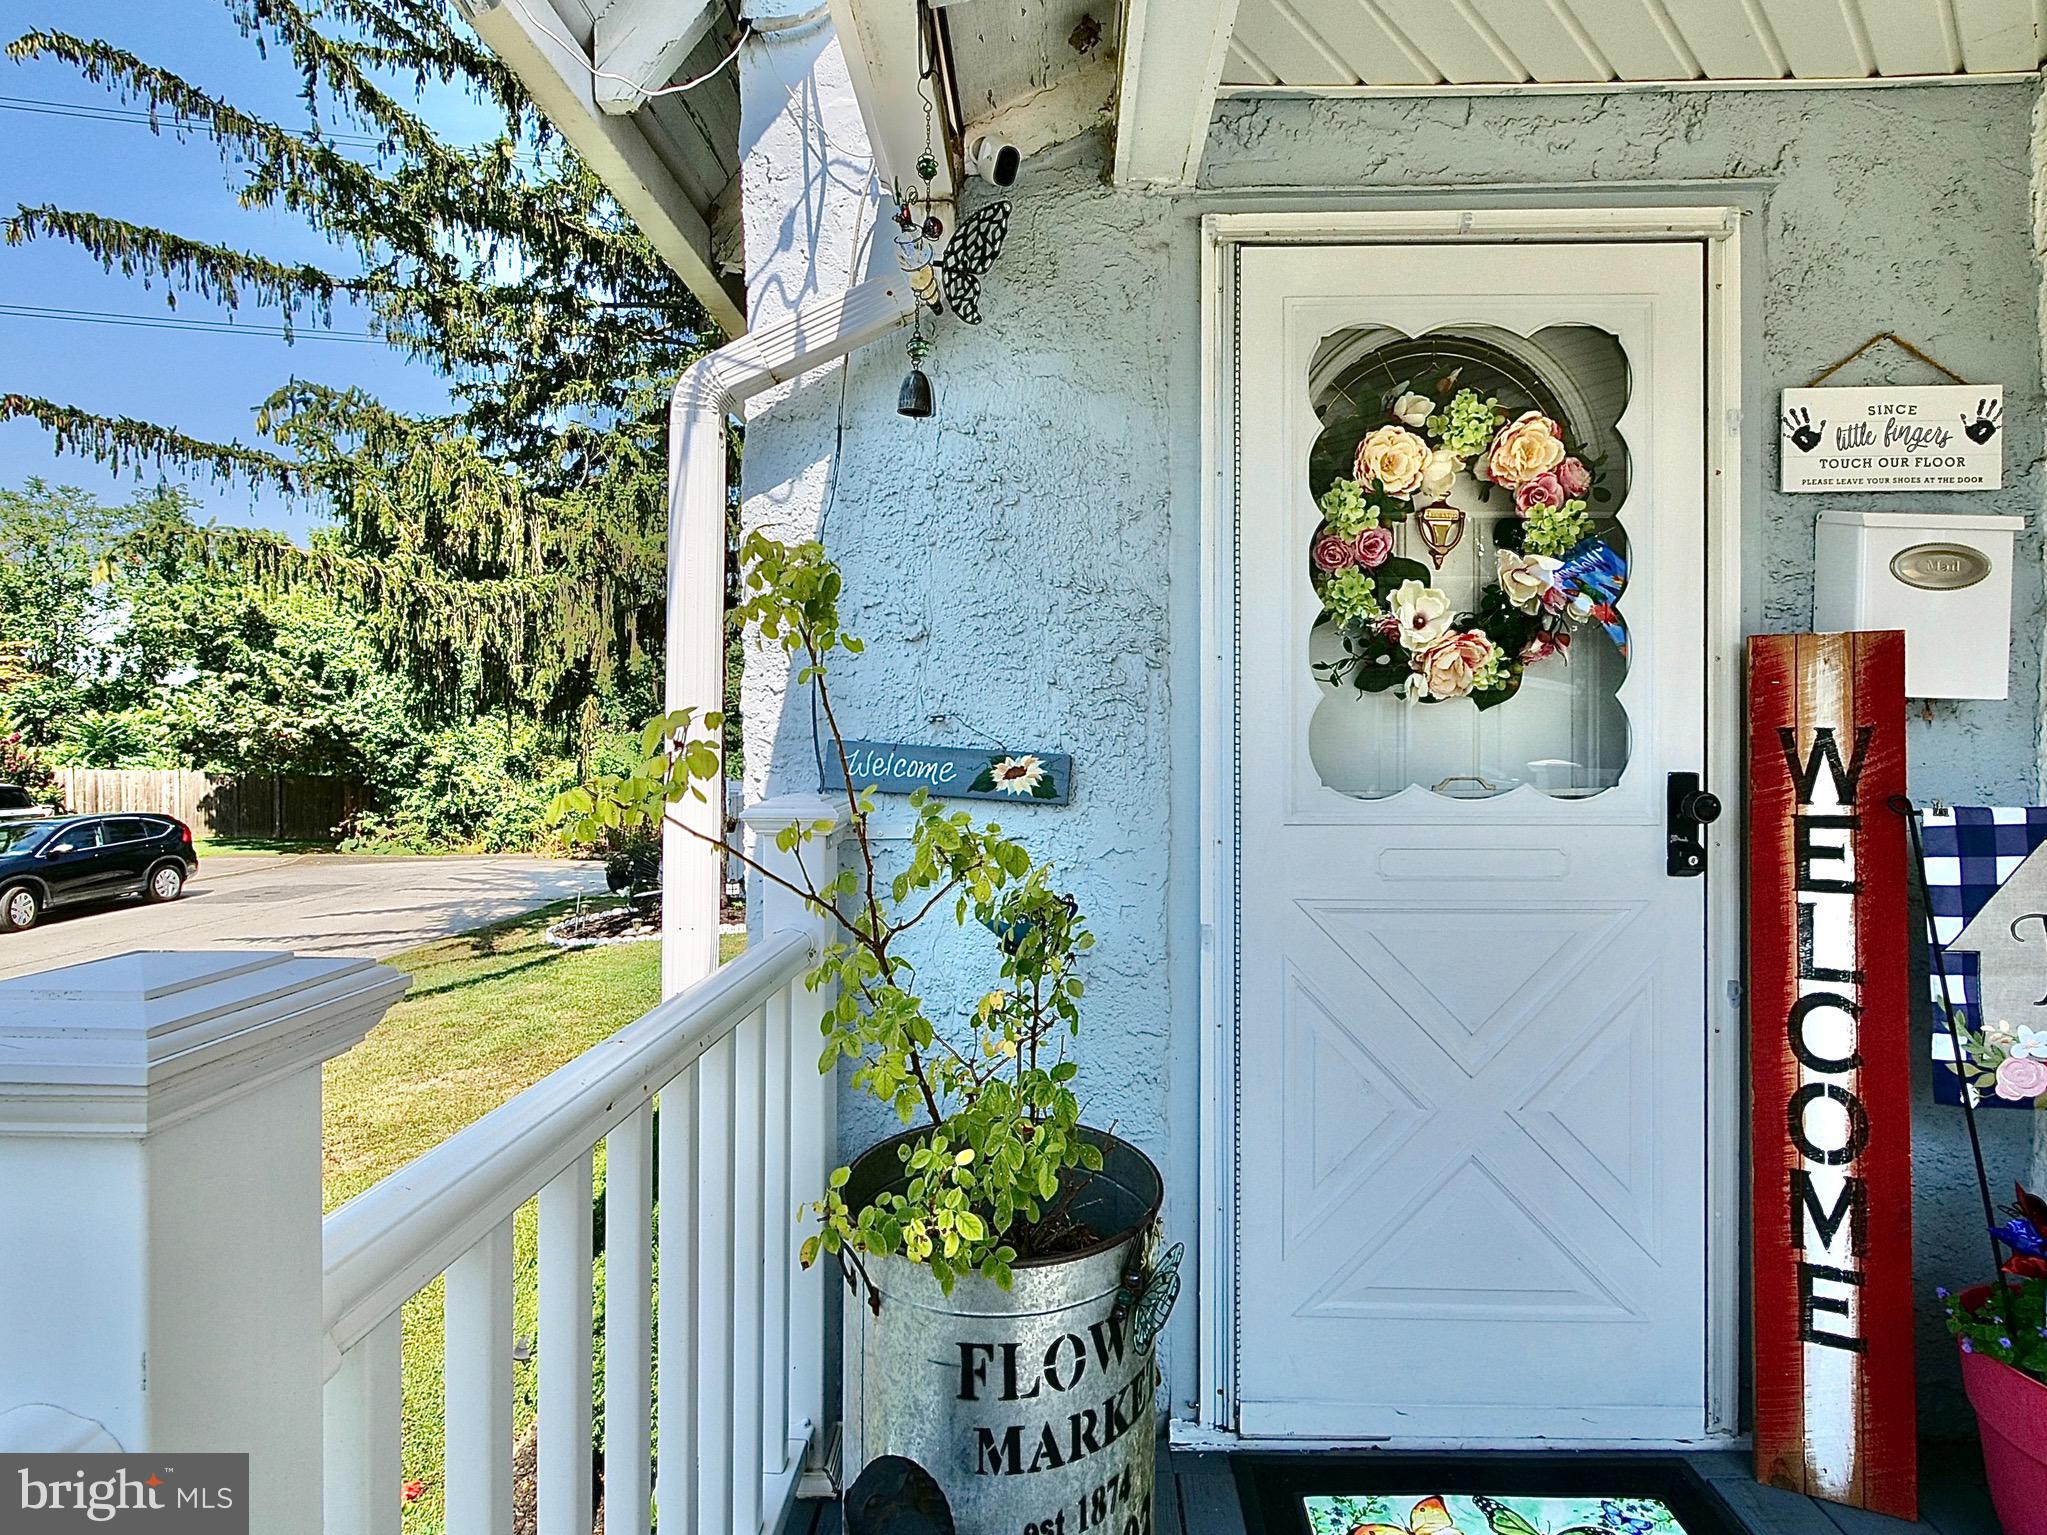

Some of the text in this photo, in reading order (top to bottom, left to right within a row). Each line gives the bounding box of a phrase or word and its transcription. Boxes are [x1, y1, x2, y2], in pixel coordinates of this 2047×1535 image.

[1867, 404, 1918, 416] SINCE
[1836, 417, 1954, 453] little fingers
[1819, 456, 1966, 469] TOUCH OUR FLOOR
[1801, 476, 1984, 486] PLEASE LEAVE YOUR SHOES AT THE DOOR
[1926, 560, 1960, 572] Mail
[844, 749, 957, 786] Welcome
[1776, 726, 1874, 1353] WELCOME
